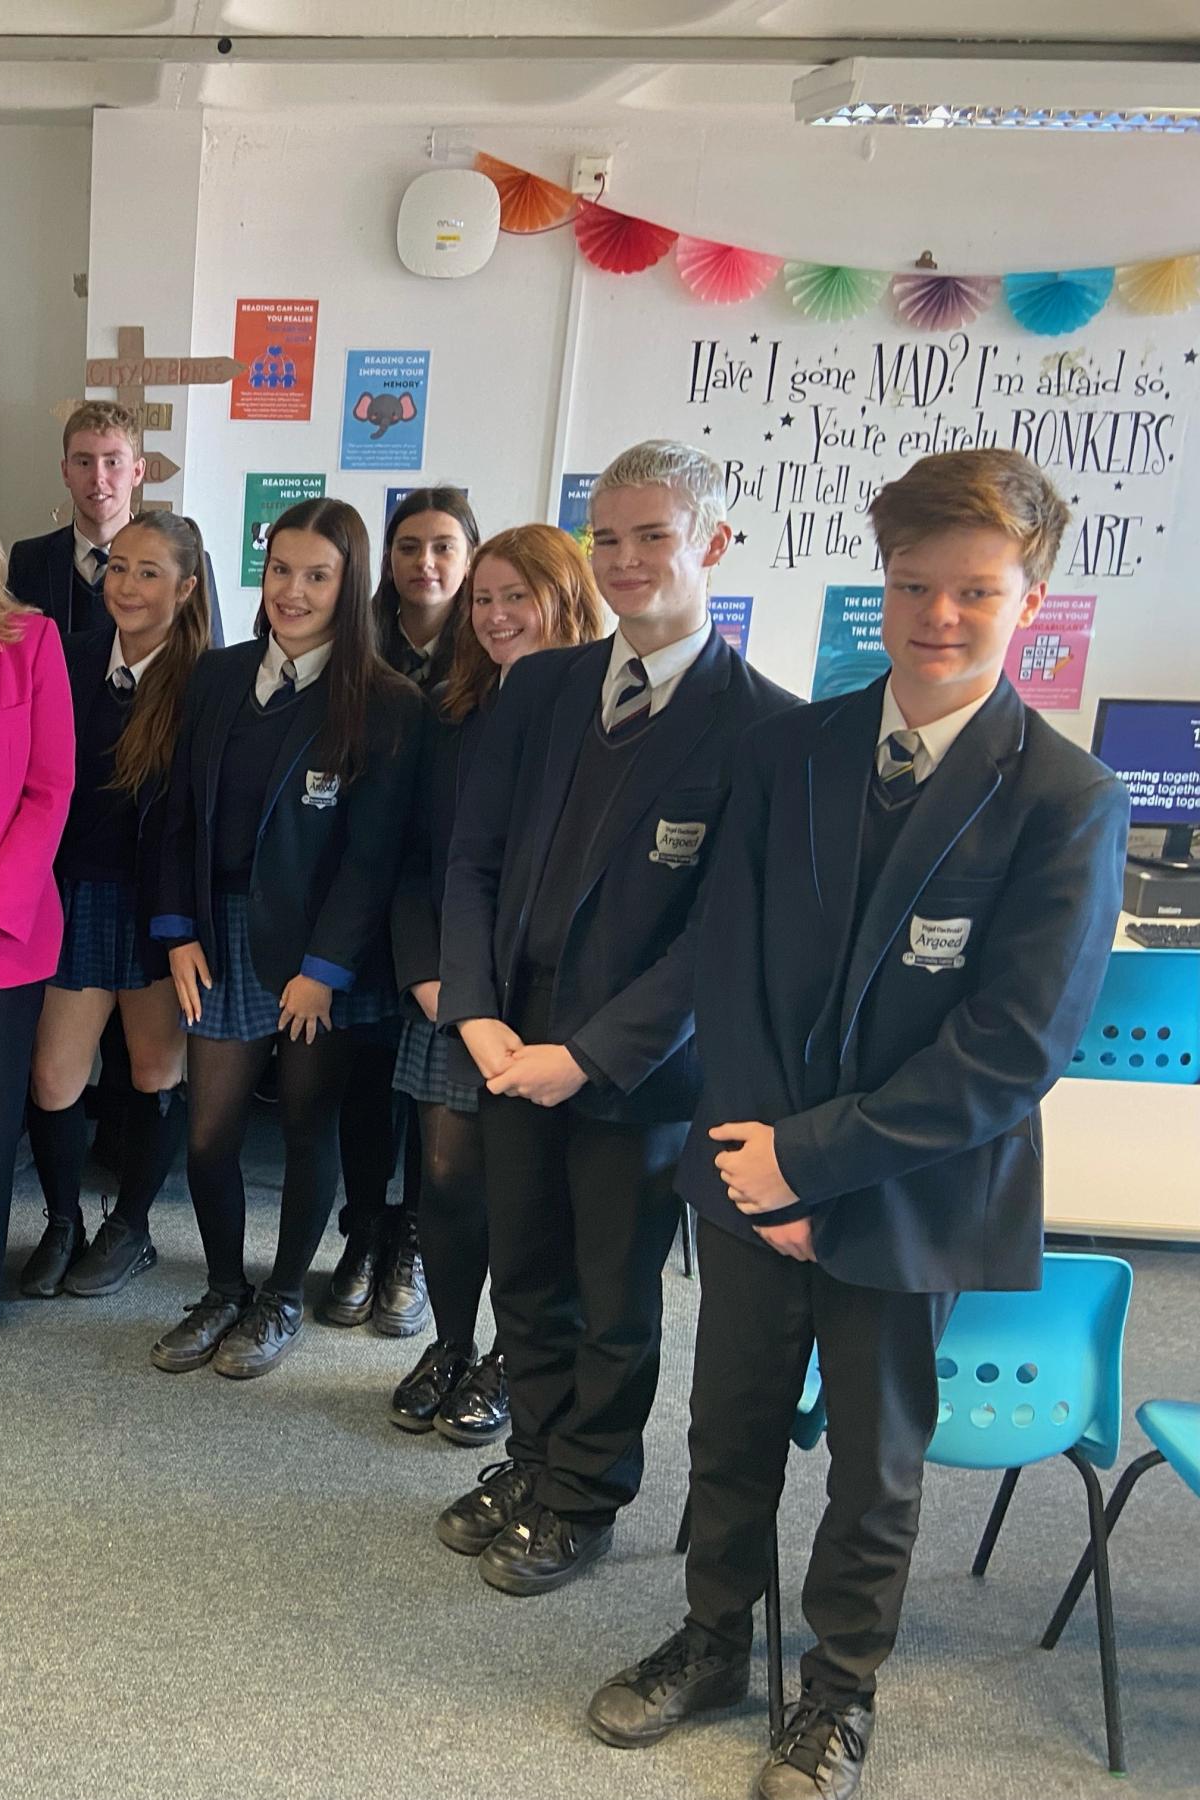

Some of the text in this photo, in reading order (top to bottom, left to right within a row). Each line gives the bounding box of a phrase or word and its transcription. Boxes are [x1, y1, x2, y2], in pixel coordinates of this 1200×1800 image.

[241, 304, 275, 312] READING
[294, 305, 314, 313] MAKE
[283, 315, 313, 323] REALISE
[364, 356, 404, 364] READING
[89, 362, 138, 384] CITY
[141, 360, 164, 384] OF
[359, 368, 424, 377] IMPROVE YOUR
[687, 340, 753, 404] Have
[763, 341, 782, 405] I
[788, 366, 856, 402] gone
[864, 333, 970, 407] MAD?
[971, 345, 1025, 409] I'm
[1036, 350, 1127, 397] afraid
[809, 403, 887, 464] You're
[1011, 408, 1175, 476] BONKERS.
[262, 479, 301, 487] READING
[723, 460, 768, 511] But
[771, 460, 808, 513] I'll
[816, 464, 850, 504] tell
[280, 490, 301, 498] HELP
[769, 508, 816, 569] All
[825, 511, 862, 559] the
[1064, 513, 1143, 578] ARE.
[709, 601, 746, 609] EADING
[844, 597, 882, 607] THE BEST
[726, 613, 745, 621] YOU
[1039, 612, 1062, 620] ROVE
[852, 626, 867, 636] THE
[1115, 769, 1200, 784] earning togeth
[1158, 783, 1200, 797] togethe
[1176, 796, 1200, 809] toge
[915, 934, 963, 950] Argoed
